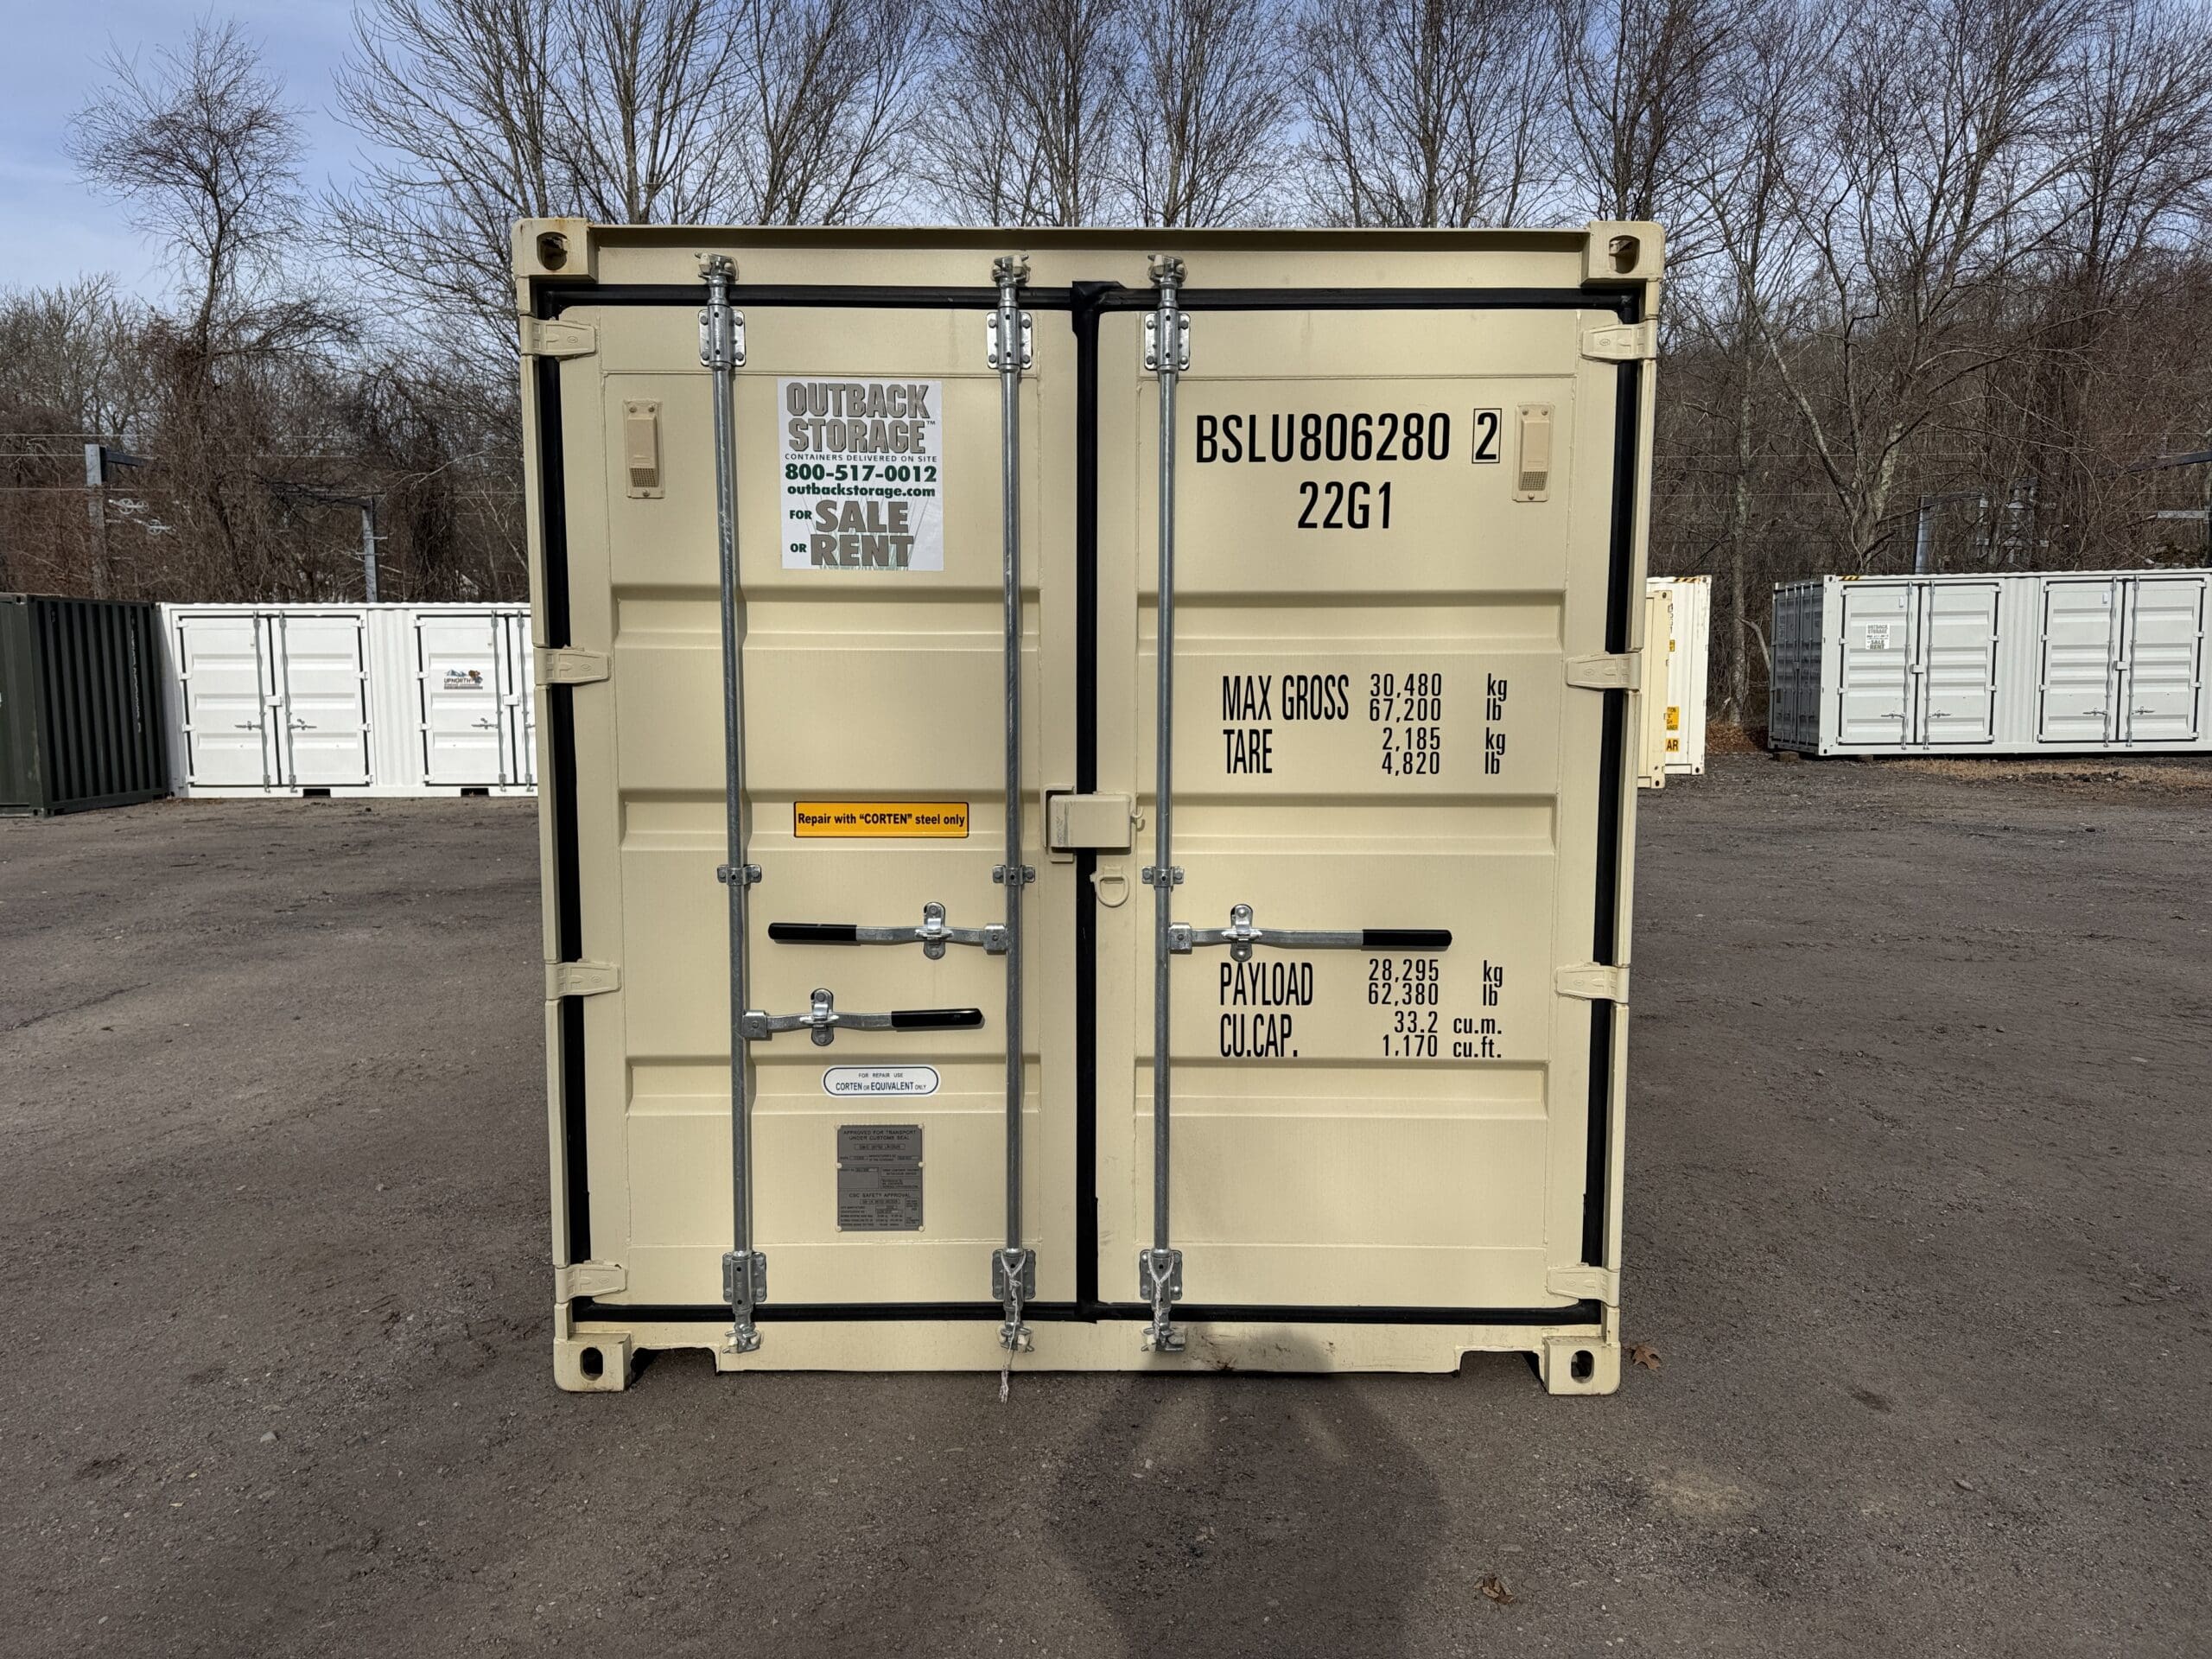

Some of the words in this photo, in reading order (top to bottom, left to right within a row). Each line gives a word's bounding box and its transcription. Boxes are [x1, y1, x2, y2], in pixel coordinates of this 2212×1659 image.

[786, 382, 931, 418] OUTBACK
[788, 418, 925, 454] STORAGE
[1196, 412, 1451, 463] BSLU806280
[1475, 412, 1498, 460] 2
[785, 453, 843, 461] CONTAINERS
[785, 463, 937, 482] 800-517-0012
[787, 483, 936, 499] outbackstorage.com
[1297, 480, 1392, 530] 22G1
[789, 510, 812, 519] FOR
[815, 499, 909, 533] SALE
[790, 543, 807, 553] OR
[810, 534, 914, 567] RENT
[1222, 675, 1272, 721] MAX
[1281, 674, 1349, 721] GROSS
[1370, 673, 1442, 698] 30,480
[1487, 673, 1508, 702] kg
[1370, 698, 1441, 723] 67,200
[1486, 697, 1502, 721] lb
[1223, 728, 1273, 774] TARE
[1382, 727, 1440, 752] 2,185
[1485, 727, 1506, 756] kg
[1382, 752, 1440, 777] 4,820
[1484, 752, 1500, 775] lb
[798, 813, 831, 826] Repair
[834, 813, 856, 824] with
[915, 814, 940, 825] steel
[944, 814, 965, 827] only
[1220, 962, 1313, 1006] PAYLOAD
[1369, 958, 1439, 983] 28,295
[1483, 960, 1503, 988] kg
[1368, 982, 1439, 1007] 62,380
[1483, 983, 1498, 1007] lb
[1220, 1014, 1298, 1058] CU.CAP.
[1394, 1011, 1438, 1034] 33.2
[1453, 1018, 1503, 1034] cu.m.
[1382, 1034, 1438, 1057] 1,170
[1452, 1036, 1502, 1058] cu.ft.
[836, 1082, 862, 1090] CORTEN
[870, 1081, 913, 1090] EQUIVALENT
